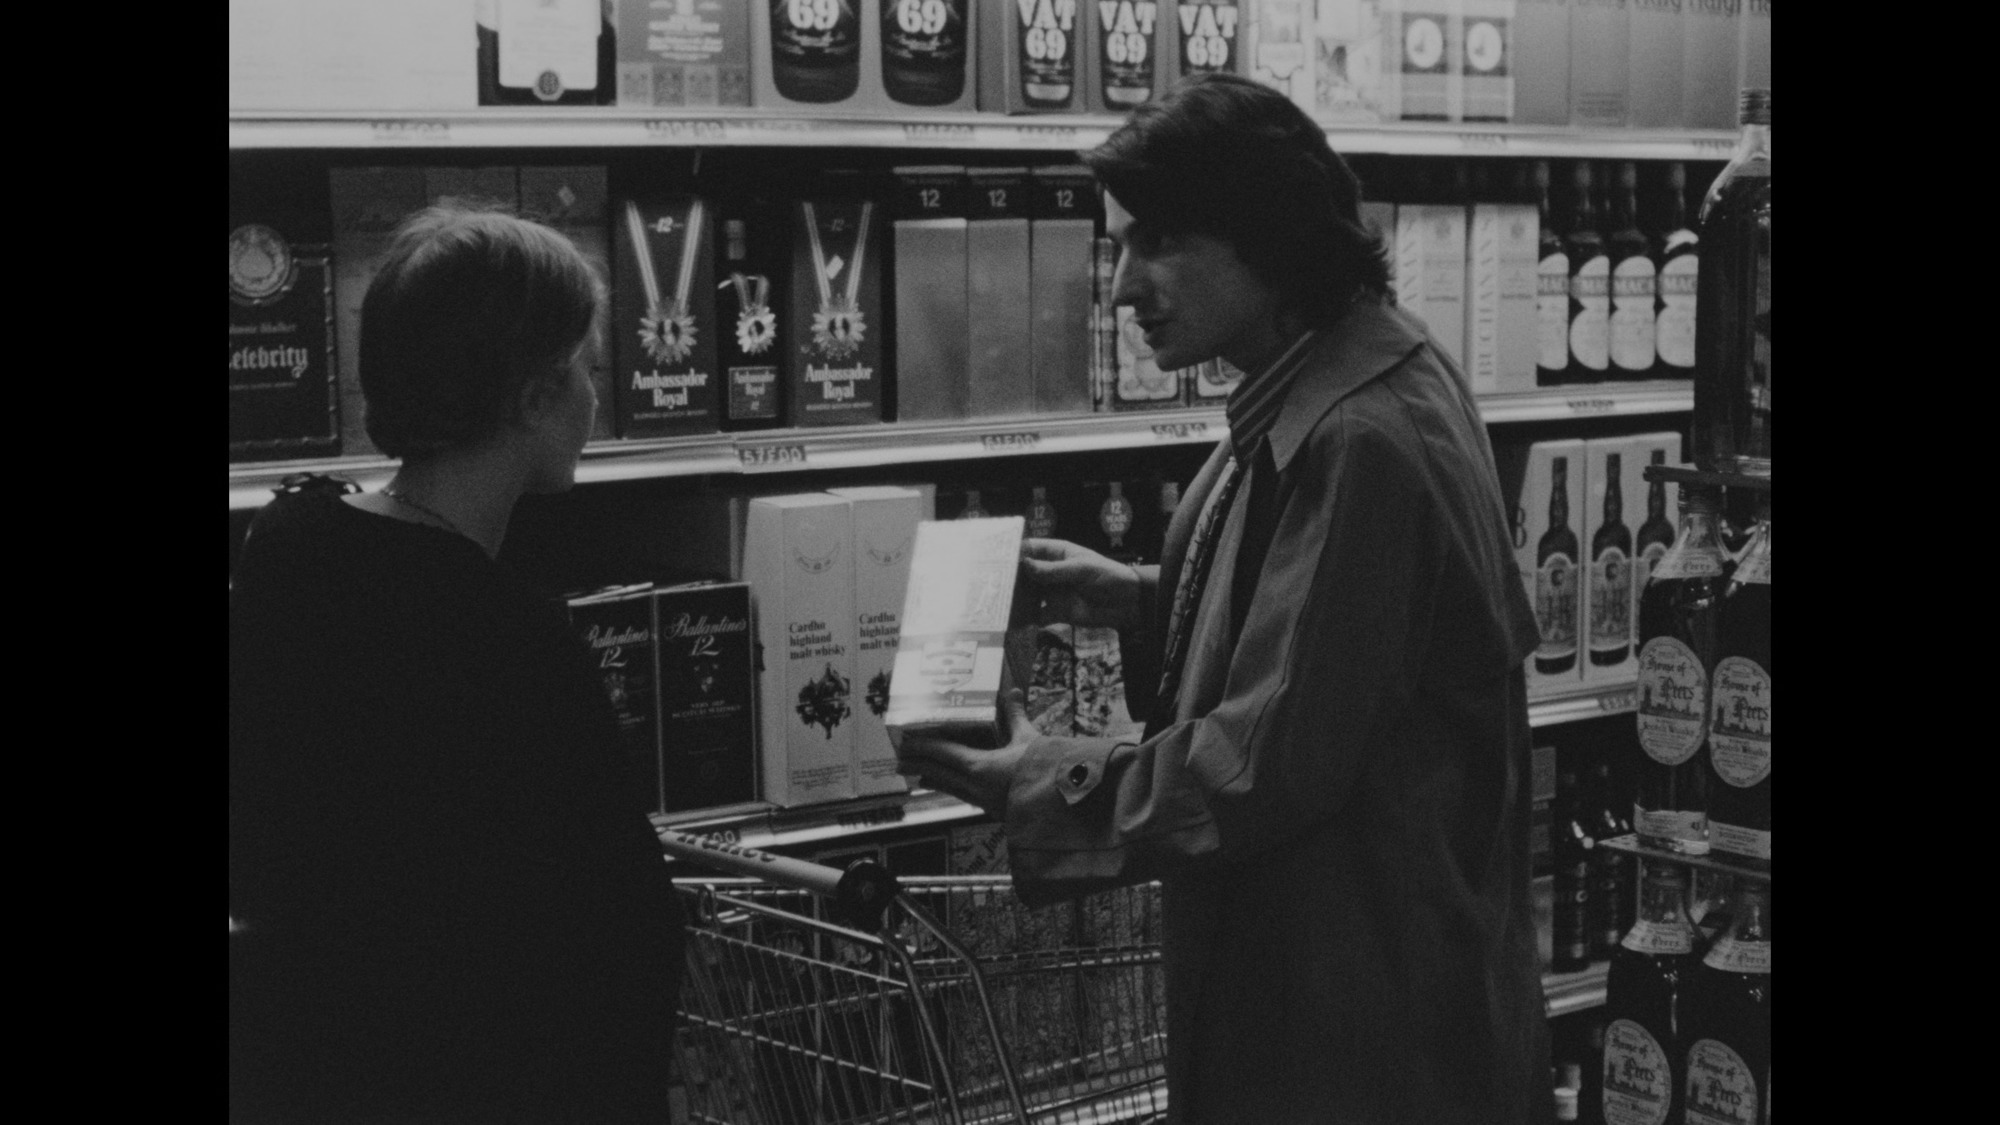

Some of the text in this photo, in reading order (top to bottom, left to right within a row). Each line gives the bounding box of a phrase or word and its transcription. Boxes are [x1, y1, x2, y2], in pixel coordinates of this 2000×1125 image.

[787, 0, 840, 30] 69
[896, 0, 947, 35] 69
[1017, 0, 1076, 31] VAT
[1099, 0, 1157, 35] VAT
[1178, 4, 1238, 39] VAT
[1025, 27, 1067, 61] 69
[1106, 32, 1148, 64] 69
[1186, 35, 1229, 67] 69
[920, 188, 941, 208] 12
[989, 188, 1007, 208] 12
[1056, 188, 1074, 208] 12
[656, 216, 674, 233] 12
[230, 344, 309, 379] elebrity
[805, 362, 874, 383] Ambassador
[631, 367, 709, 391] Ambassador
[653, 386, 689, 410] Royal
[823, 380, 855, 402] Royal
[1034, 505, 1046, 519] 12
[1110, 500, 1122, 515] 12
[1105, 514, 1128, 524] YEARS
[1109, 523, 1126, 533] OLD
[789, 620, 827, 634] Cardhu
[858, 612, 897, 625] Cardhu
[688, 634, 723, 657] 12
[789, 631, 832, 648] highland
[859, 638, 883, 651] malt
[600, 645, 629, 669] 12
[789, 644, 846, 661] malt whisky
[1658, 675, 1695, 703] Peers
[951, 694, 965, 707] 12
[1731, 694, 1769, 723] Peers
